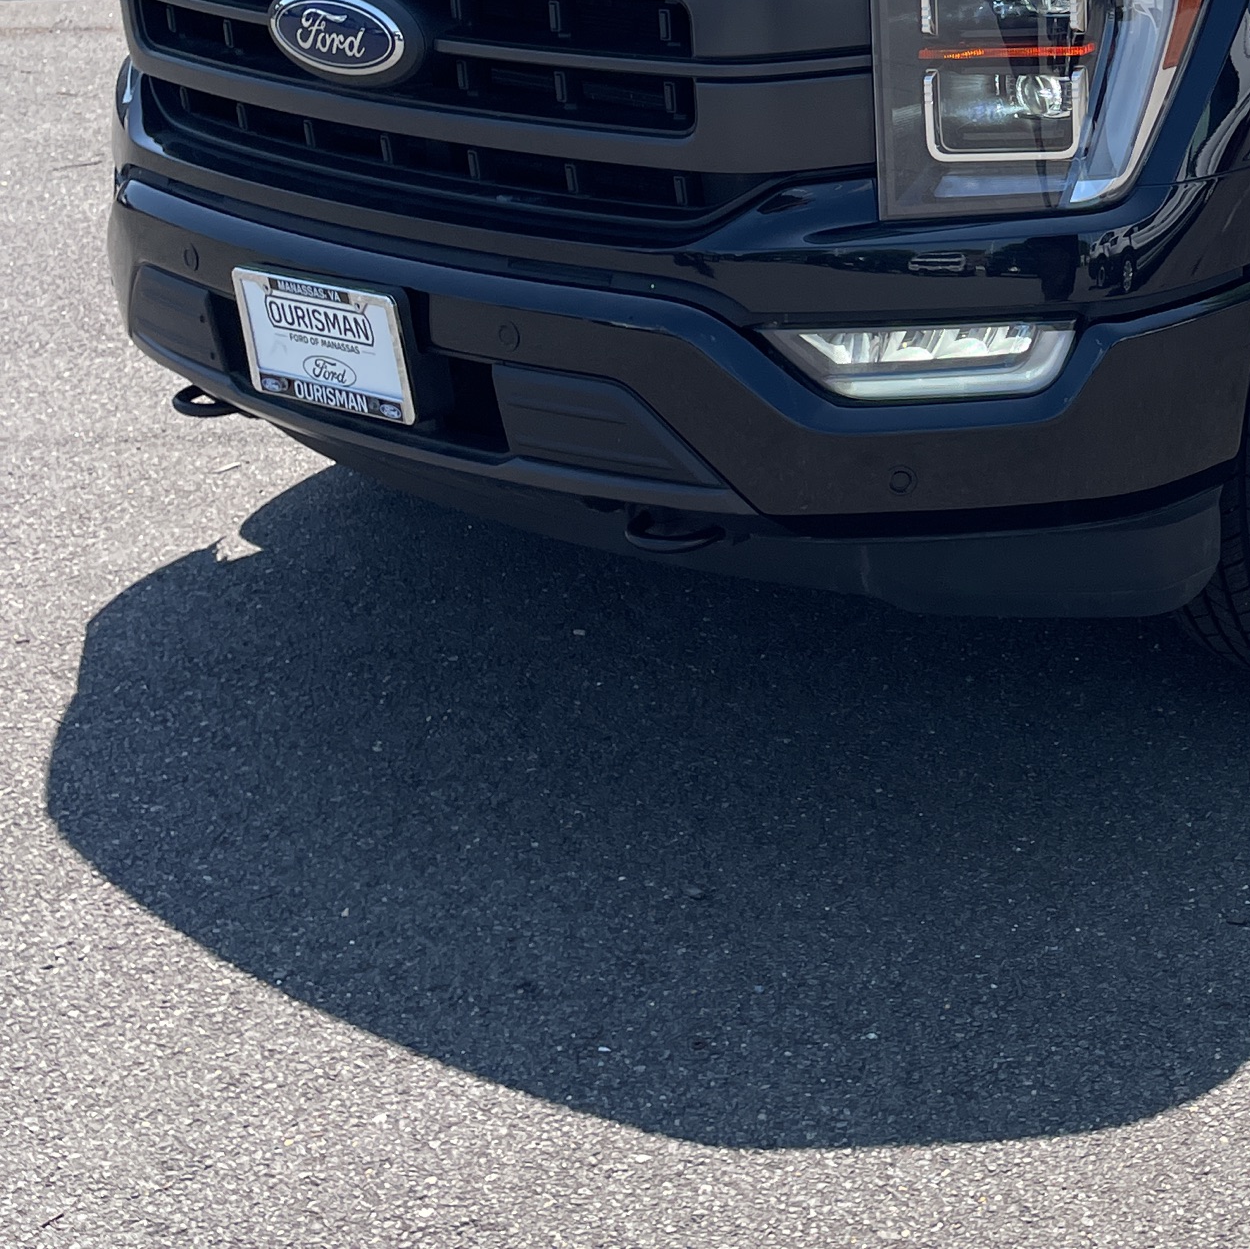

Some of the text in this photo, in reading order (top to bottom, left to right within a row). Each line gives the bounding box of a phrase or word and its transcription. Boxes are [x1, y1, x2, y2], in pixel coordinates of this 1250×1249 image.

[296, 7, 366, 58] Ford
[327, 289, 342, 303] VA
[267, 300, 371, 342] OURISMAN
[289, 332, 361, 355] FORD OF MANASSAS
[312, 357, 348, 385] Ford
[294, 380, 369, 414] OURISMAN
